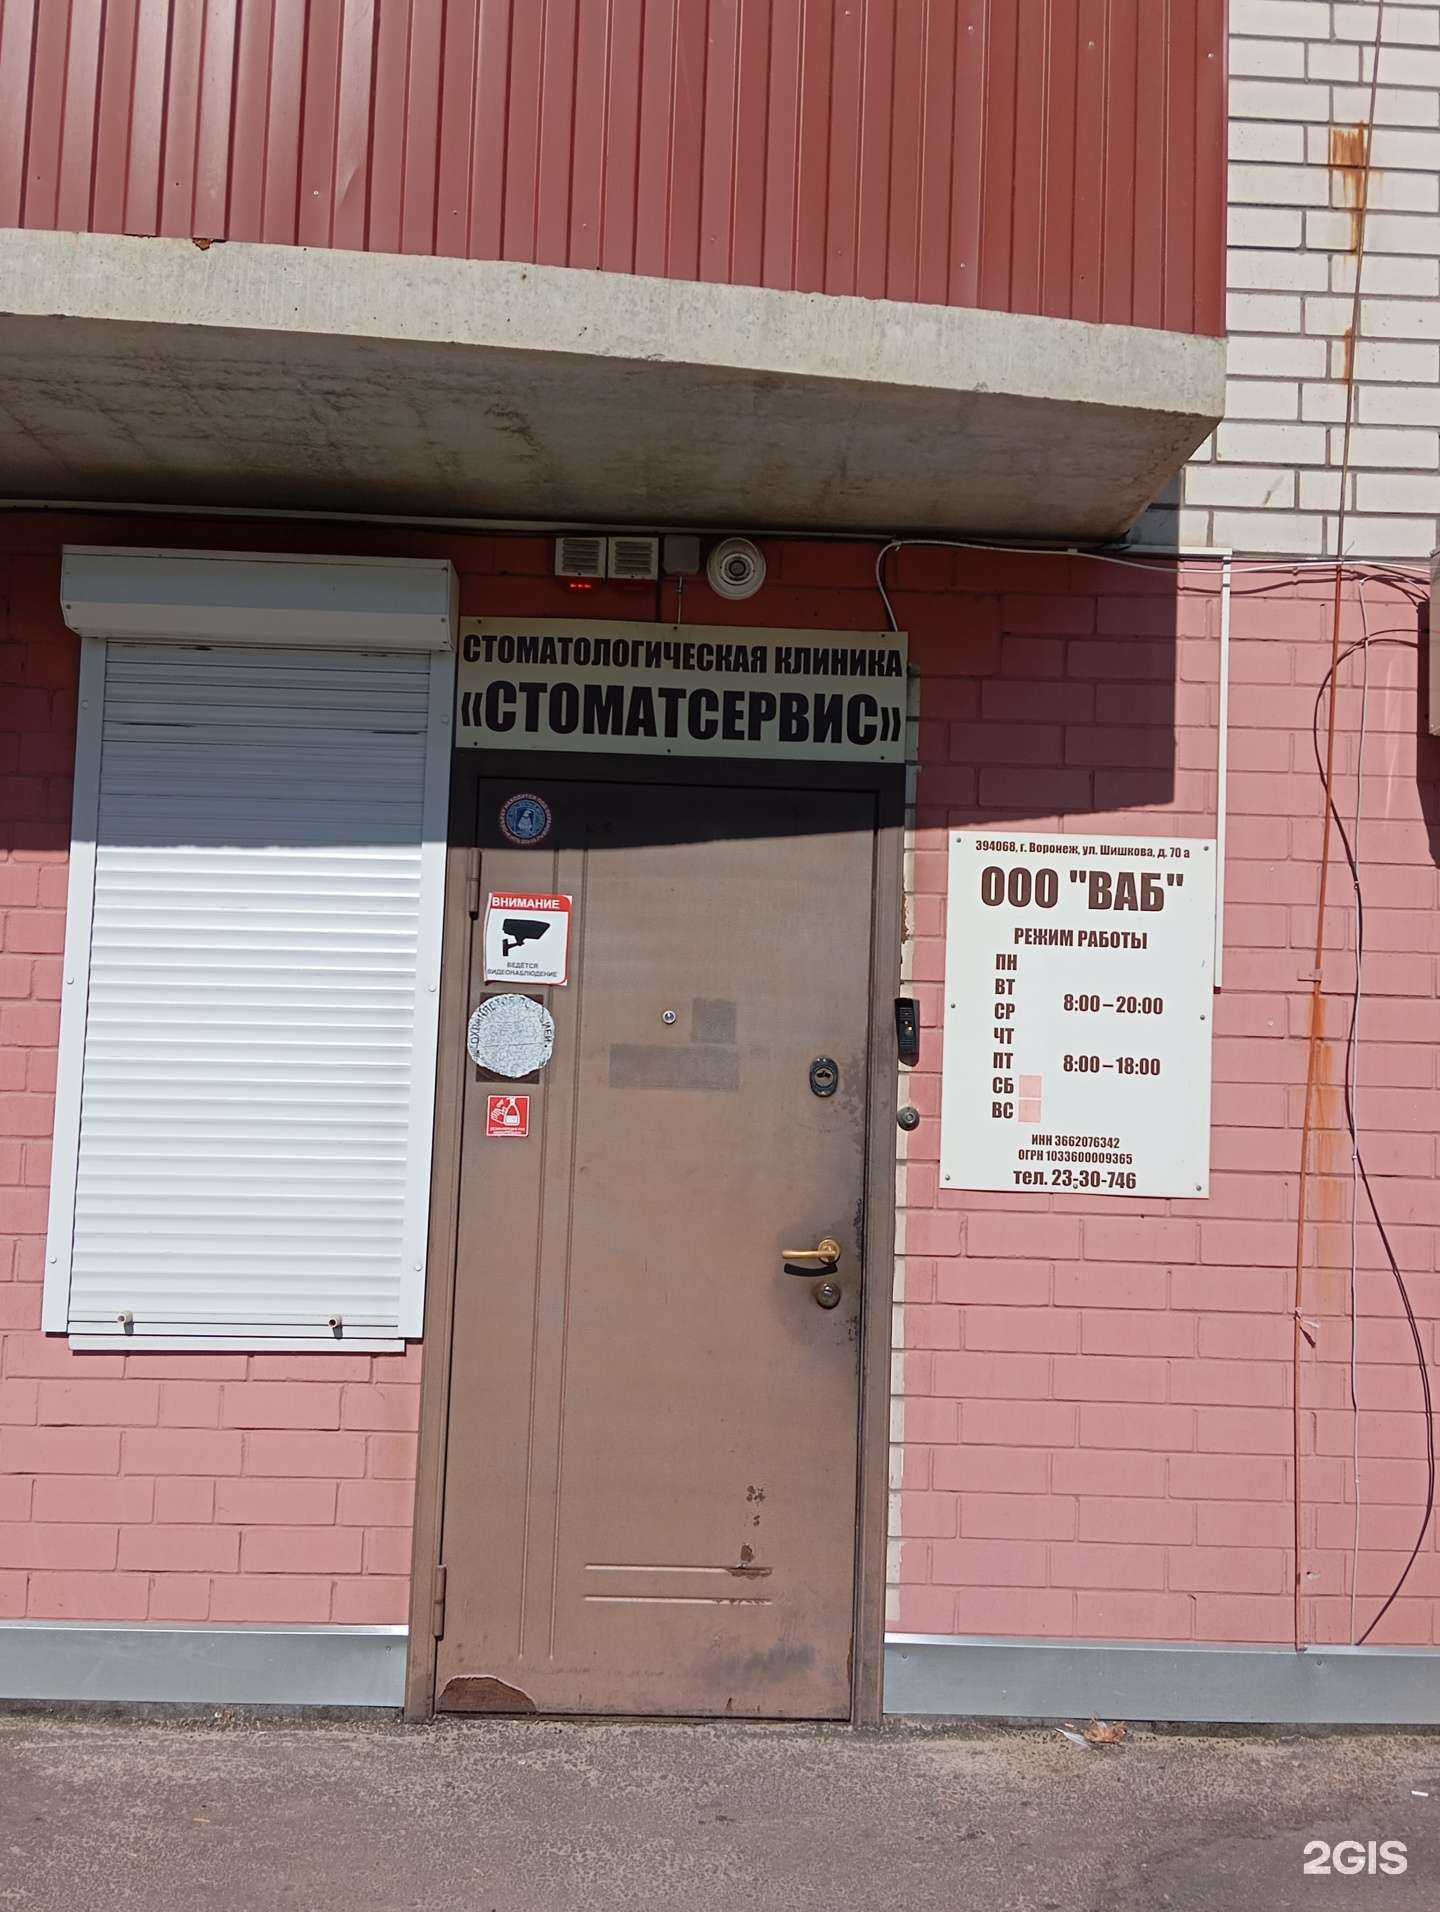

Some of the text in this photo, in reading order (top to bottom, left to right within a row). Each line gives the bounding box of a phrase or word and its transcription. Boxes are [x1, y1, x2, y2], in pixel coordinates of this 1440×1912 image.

[463, 634, 903, 678] СТОМАТОЛОГИЧЕСКАЯ КЛИНИКА
[461, 680, 901, 746] «СТОМАТСЕРВИС»
[975, 840, 1018, 854] 394068,
[1020, 843, 1027, 853] г.
[1029, 842, 1081, 856] Воронеж,
[1082, 845, 1098, 856] ул.
[1100, 845, 1156, 858] Шишкова,
[1157, 848, 1168, 859] д.
[1170, 847, 1182, 858] 70
[981, 866, 1184, 912] ООО "ВАБ"
[491, 896, 561, 909] ВНИМАНИЕ
[1014, 927, 1148, 949] РЕЖИМ РАБОТЫ
[995, 953, 1018, 970] ПН
[994, 978, 1016, 995] ВТ
[994, 1002, 1016, 1020] СР
[993, 1027, 1015, 1044] ЧТ
[993, 1052, 1014, 1069] ПТ
[992, 1077, 1014, 1094] СБ
[991, 1101, 1014, 1119] ВС
[1031, 1134, 1121, 1149] ИНН 3662076342
[1018, 1149, 1133, 1165] ОГРН 1033600009365
[1013, 1169, 1137, 1189] тел. 23-30-746
